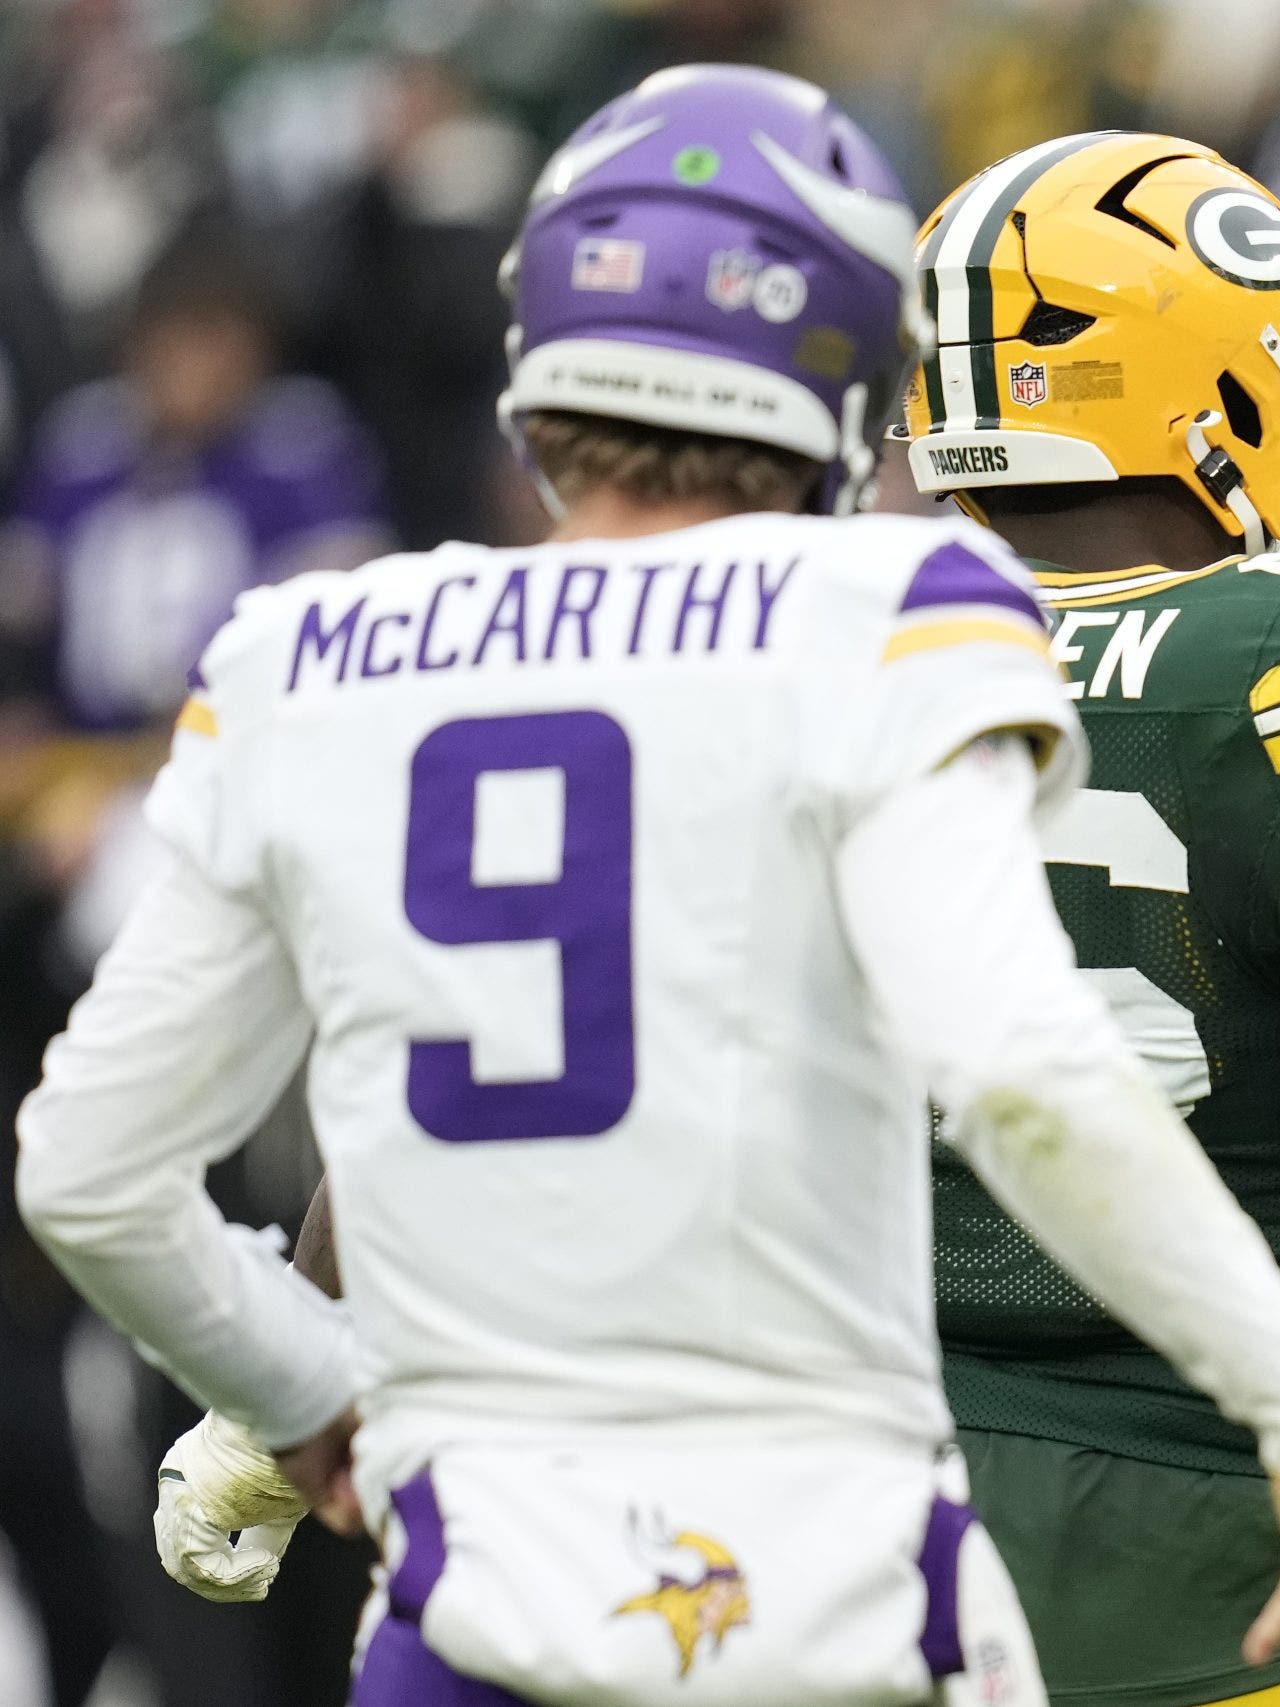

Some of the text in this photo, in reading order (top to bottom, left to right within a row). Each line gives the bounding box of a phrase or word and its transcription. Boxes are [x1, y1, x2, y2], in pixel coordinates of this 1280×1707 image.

[1014, 381, 1043, 401] NFL
[928, 445, 1009, 477] PACKERS
[285, 555, 804, 695] McCARTHY
[1047, 608, 1182, 700] EN
[404, 710, 637, 1143] 9
